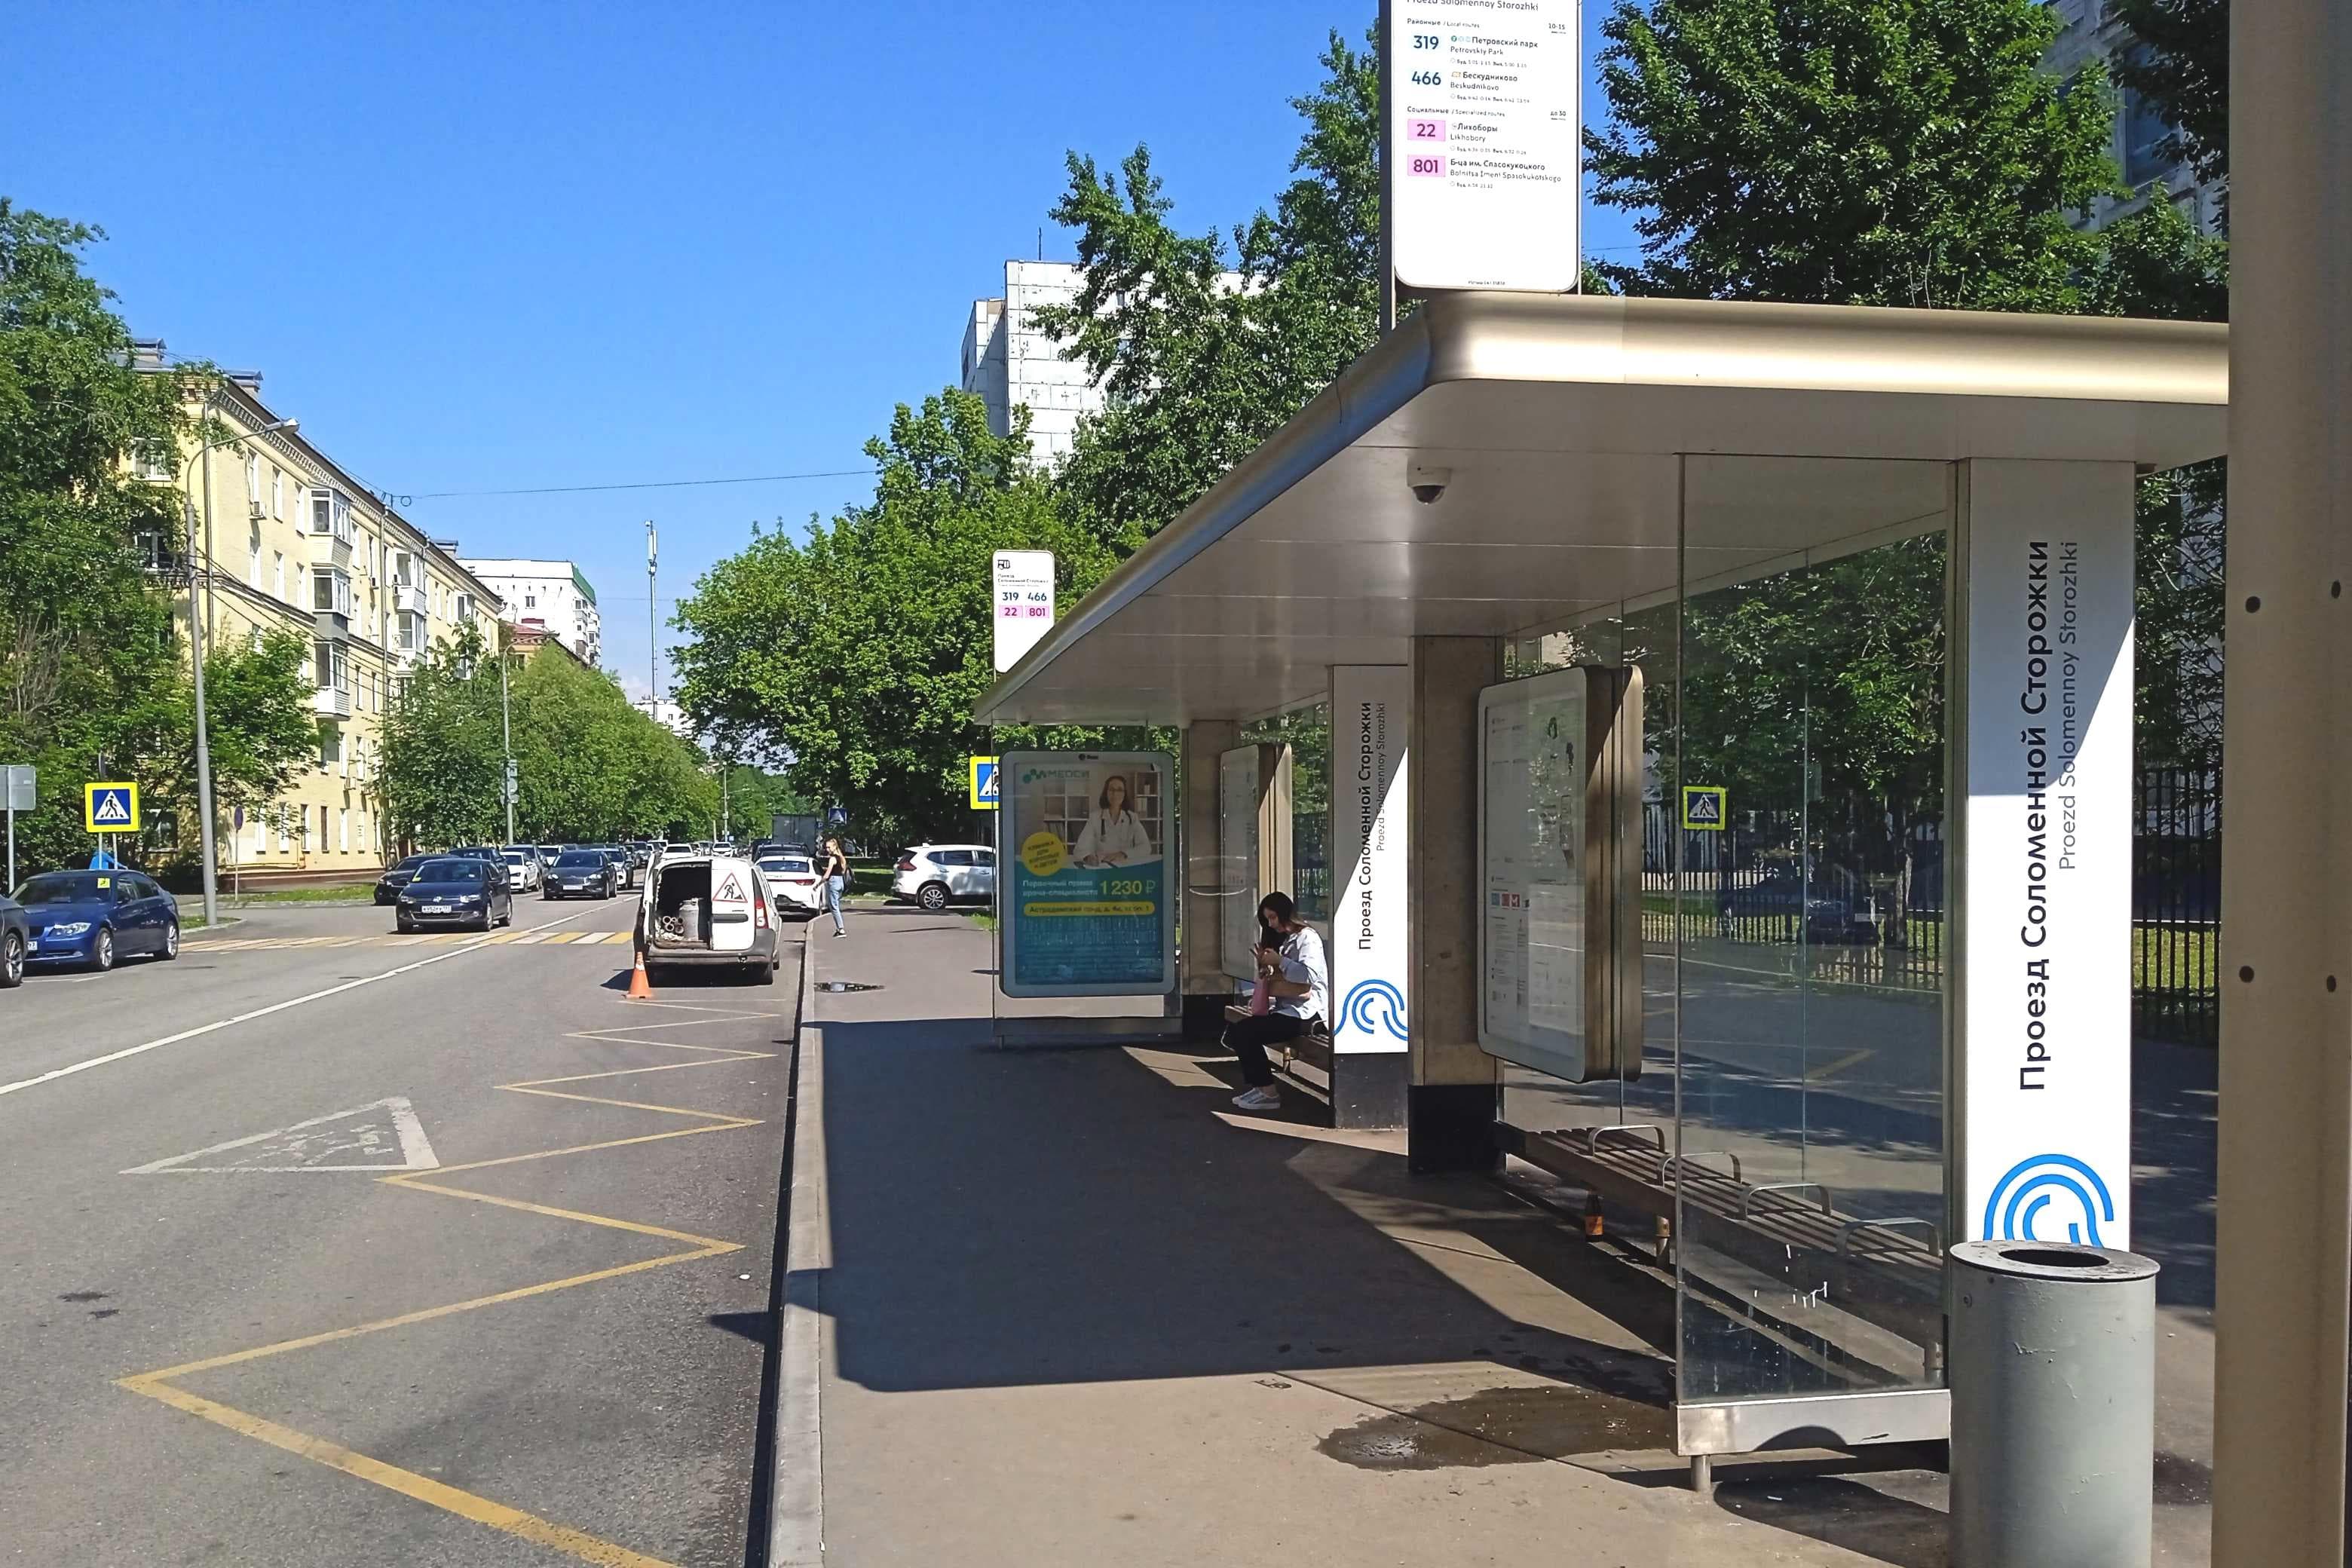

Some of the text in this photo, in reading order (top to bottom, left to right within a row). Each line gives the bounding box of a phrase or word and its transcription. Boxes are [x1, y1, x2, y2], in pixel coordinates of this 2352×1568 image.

[1497, 1, 1539, 11] Storozhki
[1413, 35, 1439, 50] 319
[1472, 36, 1517, 47] Петровский
[1450, 46, 1487, 56] Petrovskiy
[1412, 71, 1441, 85] 466
[1462, 71, 1518, 81] Бескудниково
[1450, 82, 1499, 91] Beskudnikovo
[1416, 124, 1436, 137] 22
[1457, 123, 1498, 133] Лихоборы
[1450, 133, 1486, 142] Likhobory
[1413, 159, 1438, 173] 801
[1450, 158, 1467, 167] Б-ца
[1484, 160, 1545, 170] Спасокукоцкого
[1450, 169, 1478, 177] Bolnitsa
[1502, 172, 1561, 182] Spasokukotskogo
[1002, 592, 1047, 602] 319 466
[1004, 608, 1046, 617] 22 801
[2059, 541, 2080, 869] Proezd Solomennoy Storozhki
[1377, 703, 1386, 851] Proezd Solomennoy Storozhki
[2020, 541, 2053, 1090] Проезд Соломенной Сторожки
[1358, 702, 1374, 951] Проезд Соломенной Сторожки
